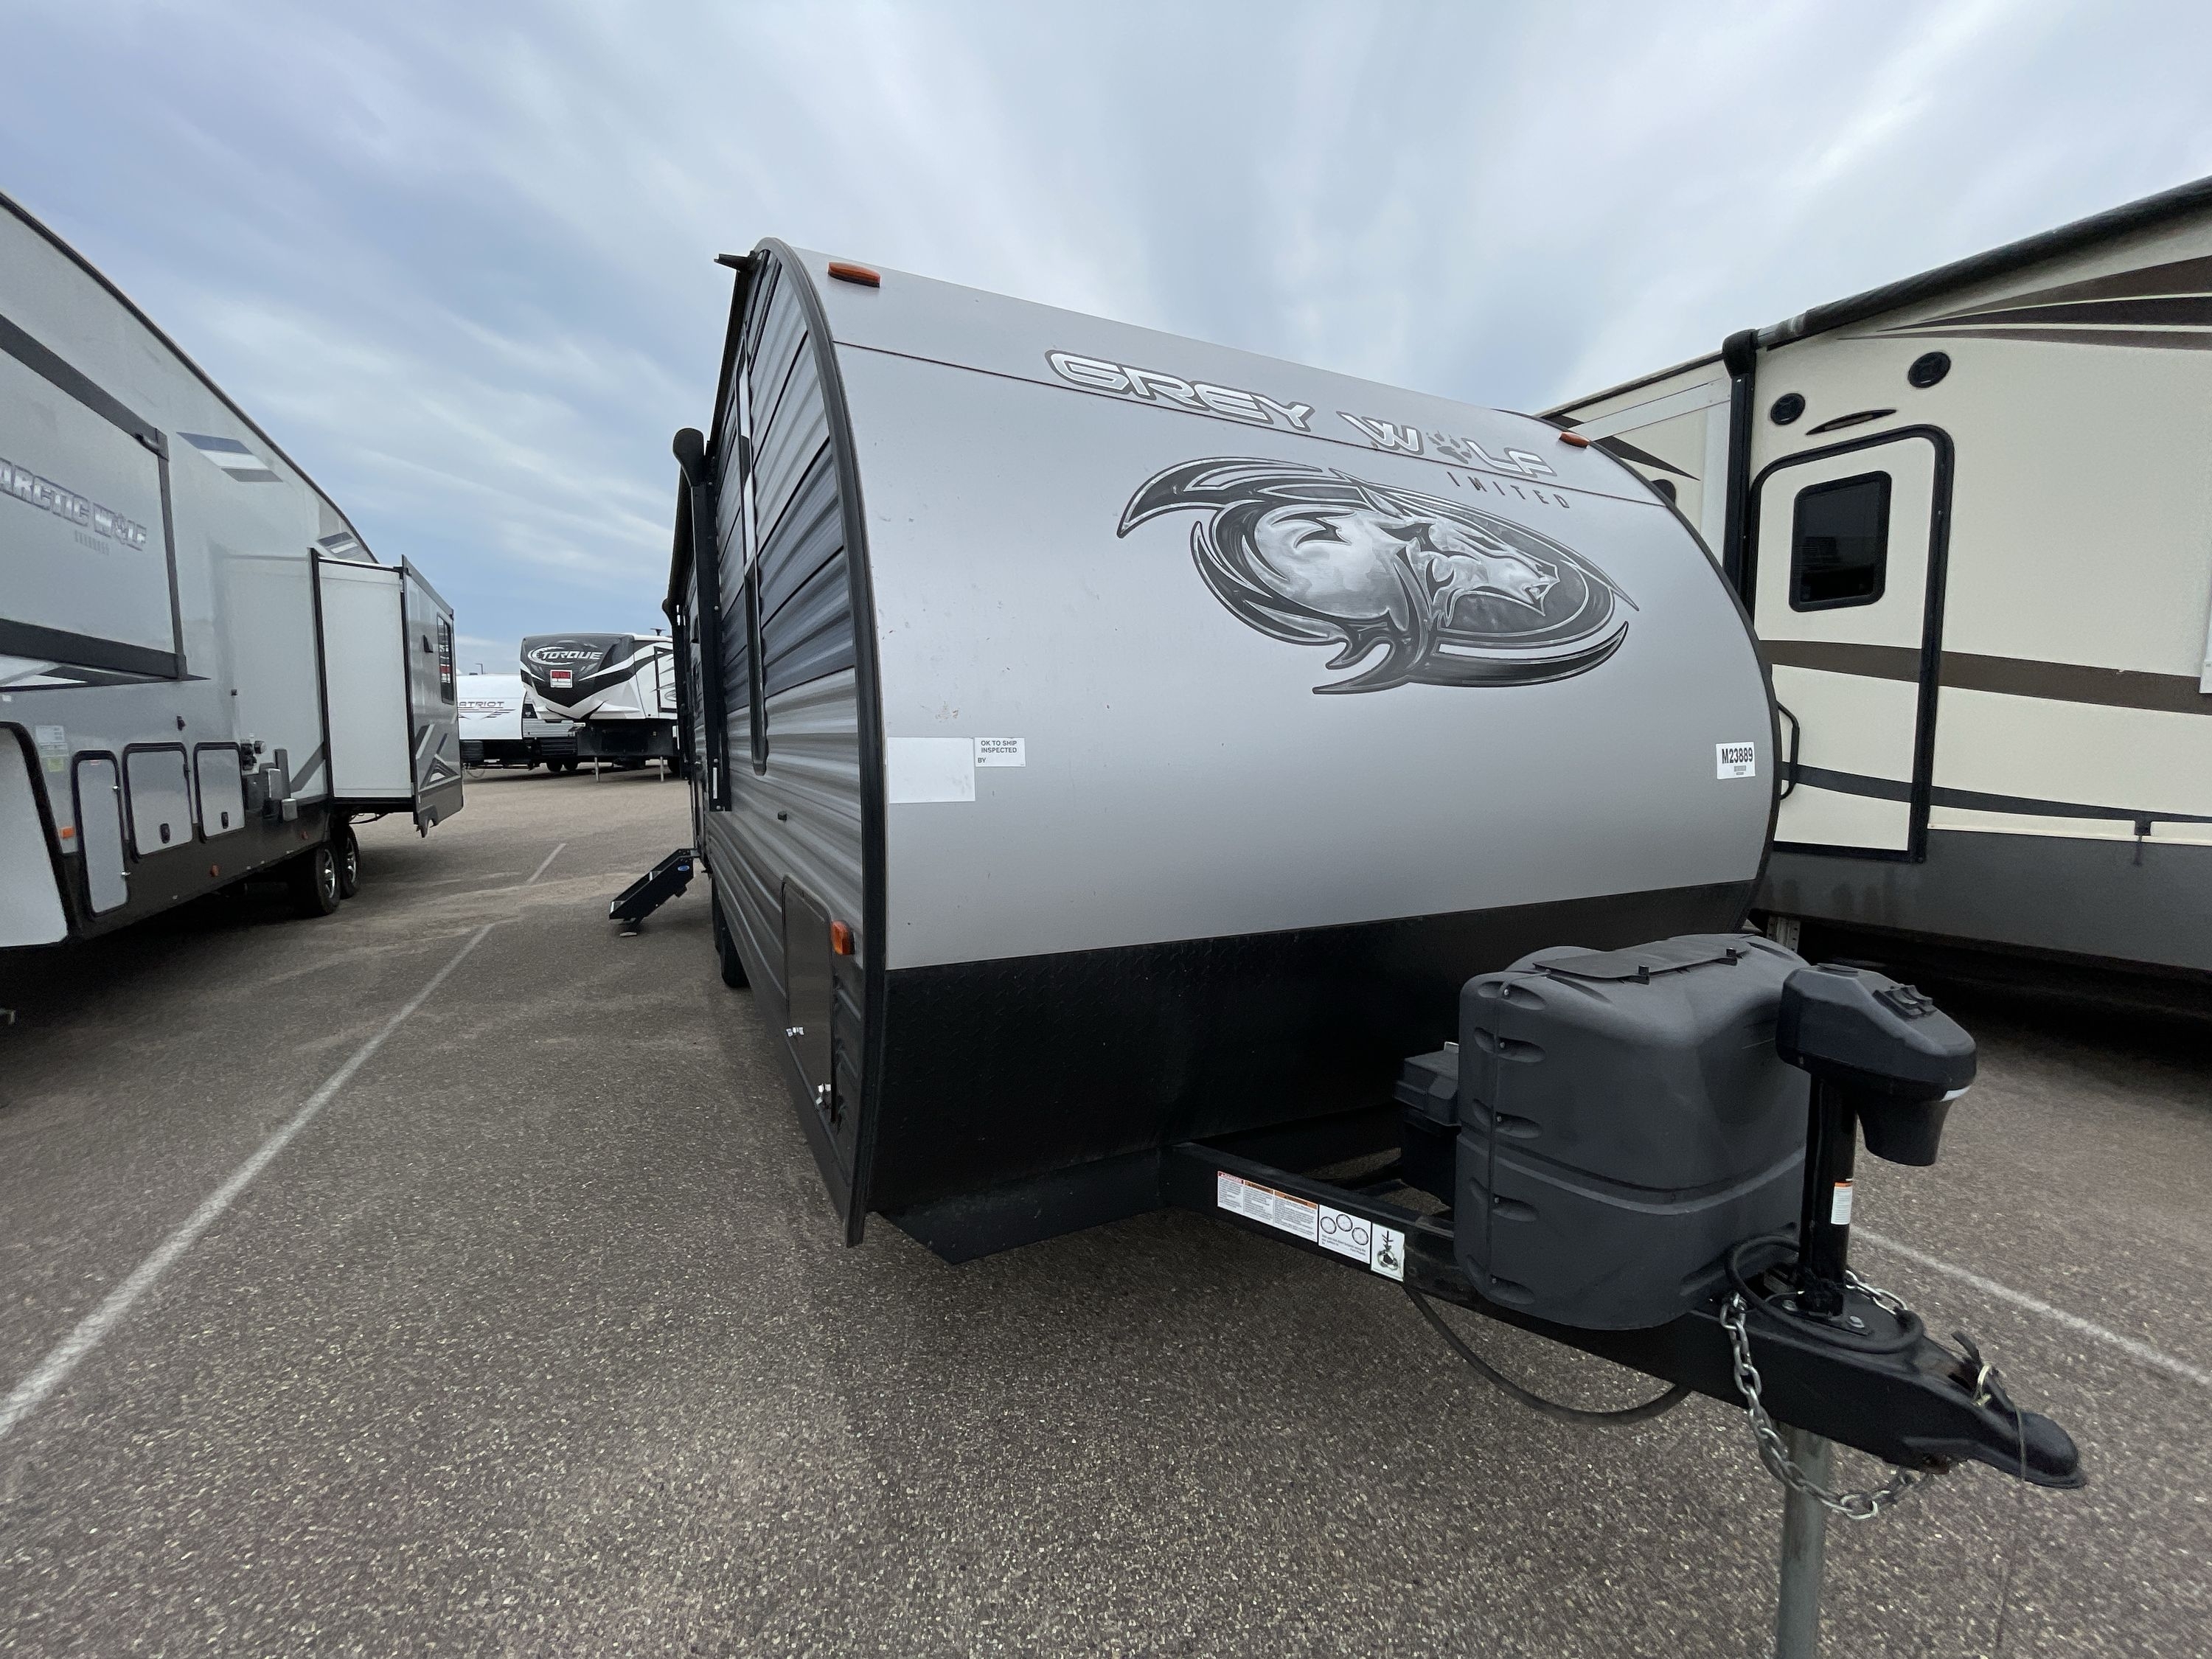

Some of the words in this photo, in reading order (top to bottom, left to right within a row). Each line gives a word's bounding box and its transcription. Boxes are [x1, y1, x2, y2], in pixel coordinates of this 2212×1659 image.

[1044, 349, 1317, 433] GREY
[541, 650, 603, 660] TORQUE
[1722, 748, 1753, 764] M23889
